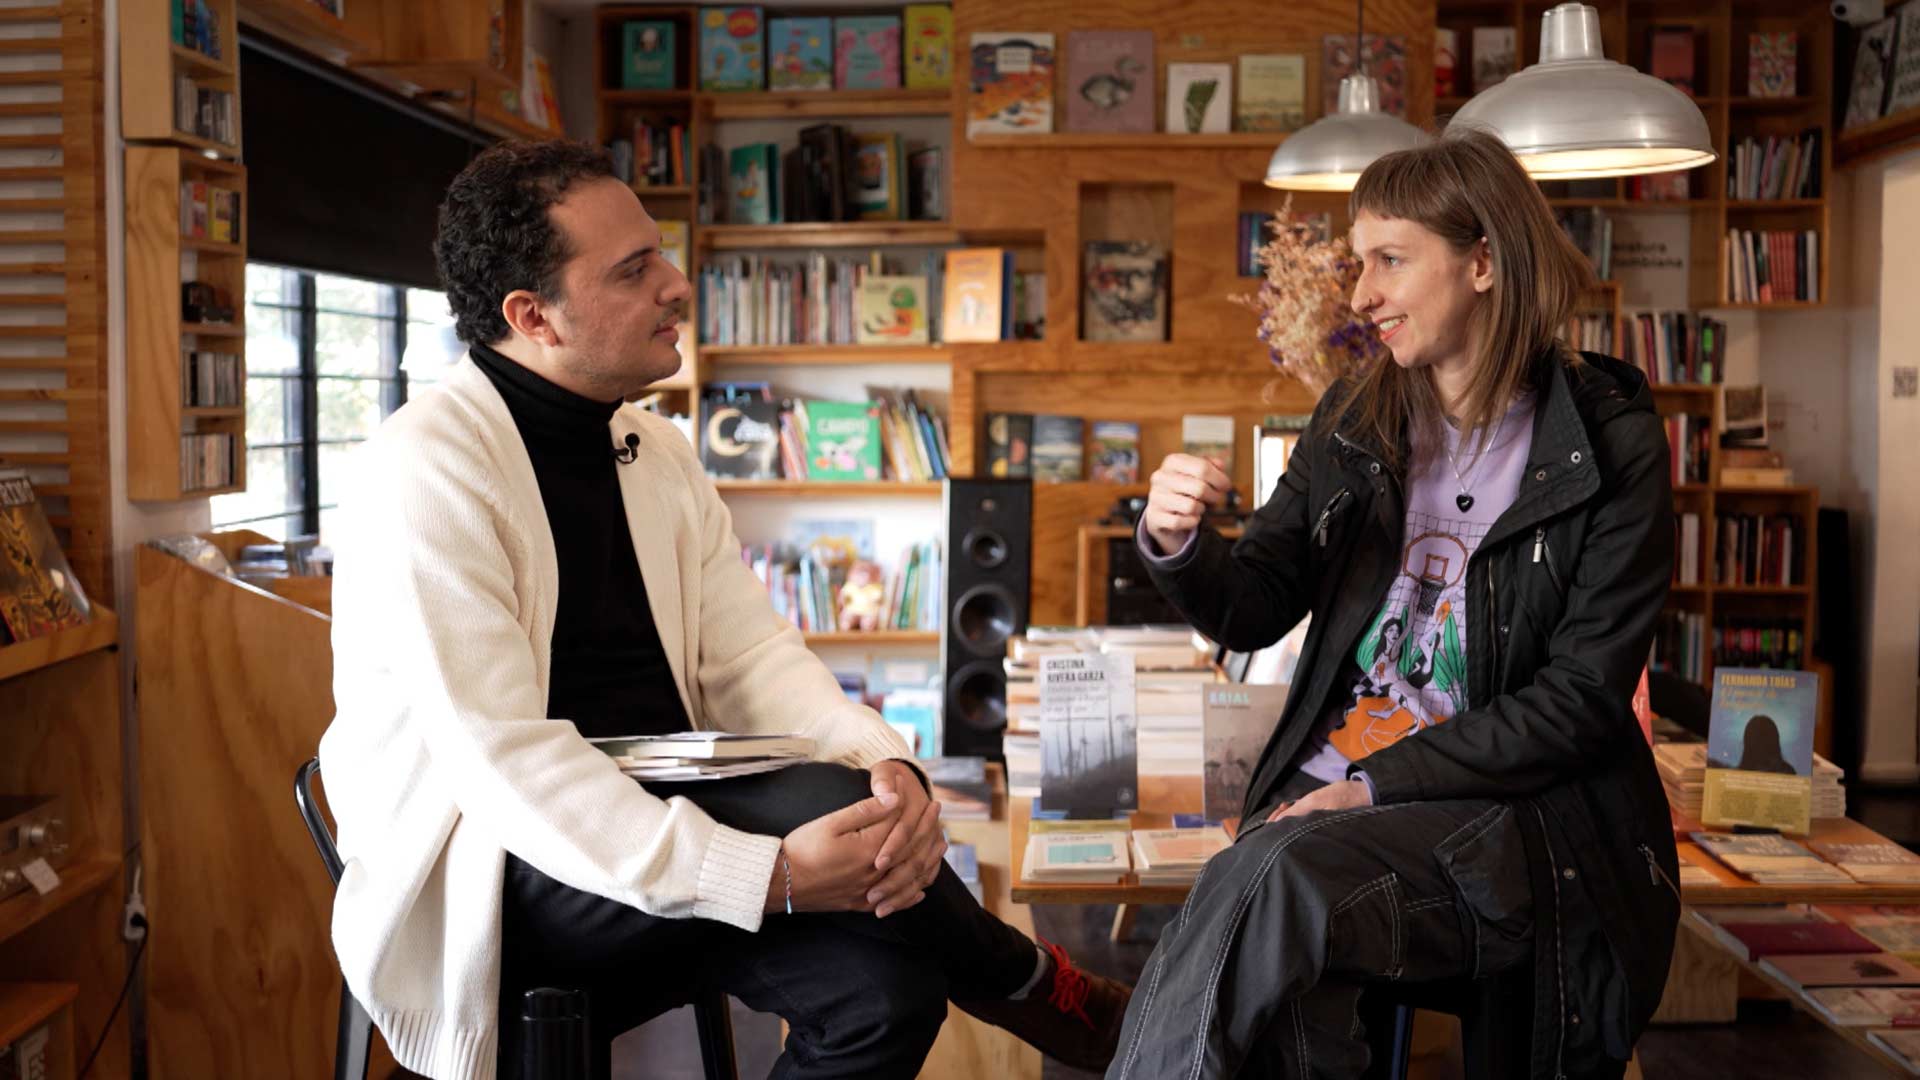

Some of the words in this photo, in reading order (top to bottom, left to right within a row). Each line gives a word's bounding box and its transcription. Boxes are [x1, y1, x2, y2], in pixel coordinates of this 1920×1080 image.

[1047, 659, 1084, 669] CRISTINA
[1047, 672, 1075, 682] RIVERA
[1077, 670, 1105, 681] GARZA
[1721, 674, 1768, 687] FERNANDA
